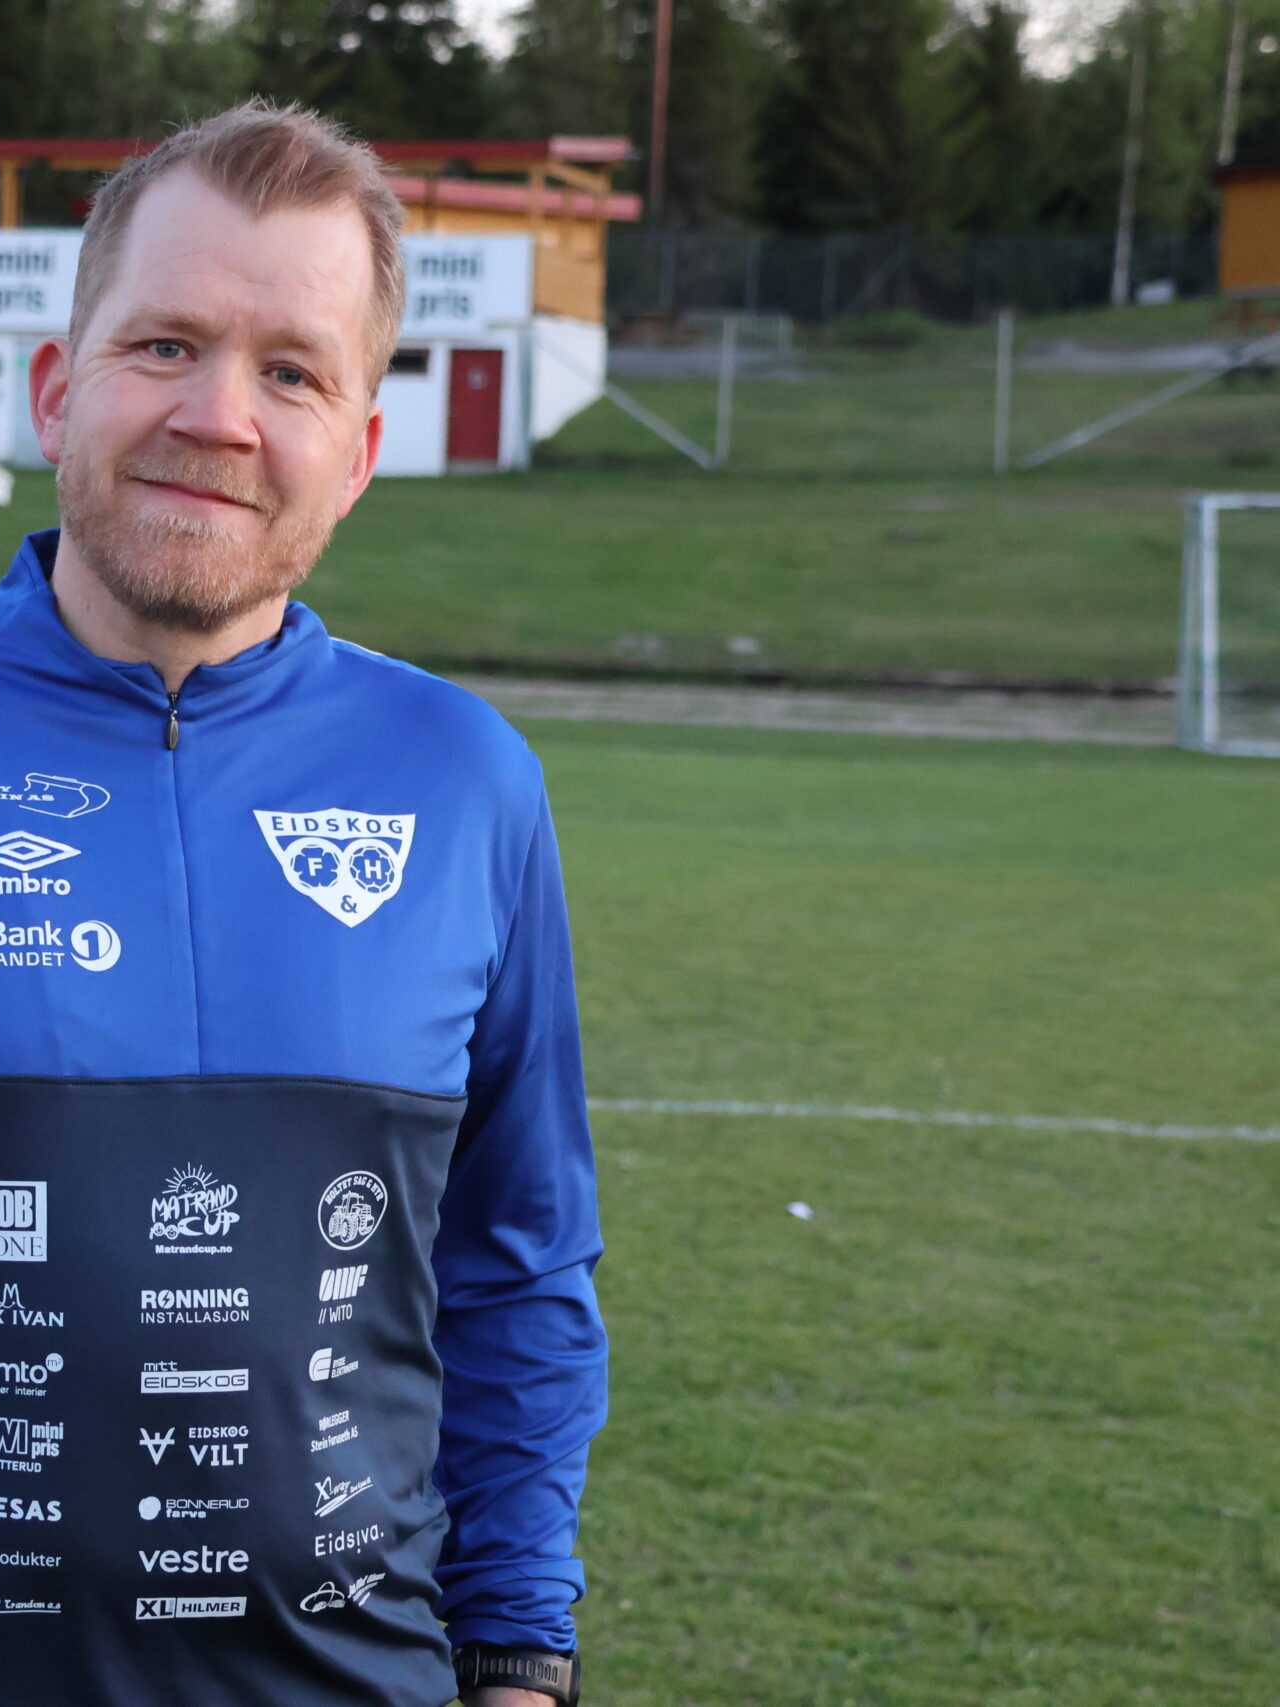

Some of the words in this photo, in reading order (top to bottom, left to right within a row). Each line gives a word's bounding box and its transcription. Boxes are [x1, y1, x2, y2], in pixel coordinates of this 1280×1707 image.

[417, 250, 480, 279] mini
[415, 289, 471, 320] pris
[27, 793, 55, 802] AS
[272, 816, 403, 834] EIDSKOG
[307, 857, 323, 876] F
[365, 859, 382, 880] H
[340, 894, 358, 914] &
[353, 1175, 368, 1186] SAG
[151, 1183, 238, 1223] MATRAND
[155, 1244, 233, 1255] Matrandcup.no
[140, 1287, 249, 1310] RØNNING
[12, 1309, 64, 1327] IVAN
[140, 1309, 250, 1324] INSTALLASJON
[329, 1303, 353, 1323] WITO
[143, 1360, 178, 1371] mitt
[15, 1385, 47, 1397] interiør
[144, 1374, 246, 1389] EIDSKOG
[31, 1421, 64, 1440] mini
[188, 1425, 249, 1439] EIDSKOG
[310, 1437, 329, 1453] Stein
[351, 1425, 359, 1439] AS
[31, 1439, 60, 1459] pris
[189, 1443, 249, 1467] VILT
[165, 1498, 250, 1510] BONNERUD
[165, 1508, 207, 1519] farve
[138, 1545, 250, 1574] vestre
[138, 1598, 173, 1618] XL
[181, 1601, 241, 1613] HILMER
